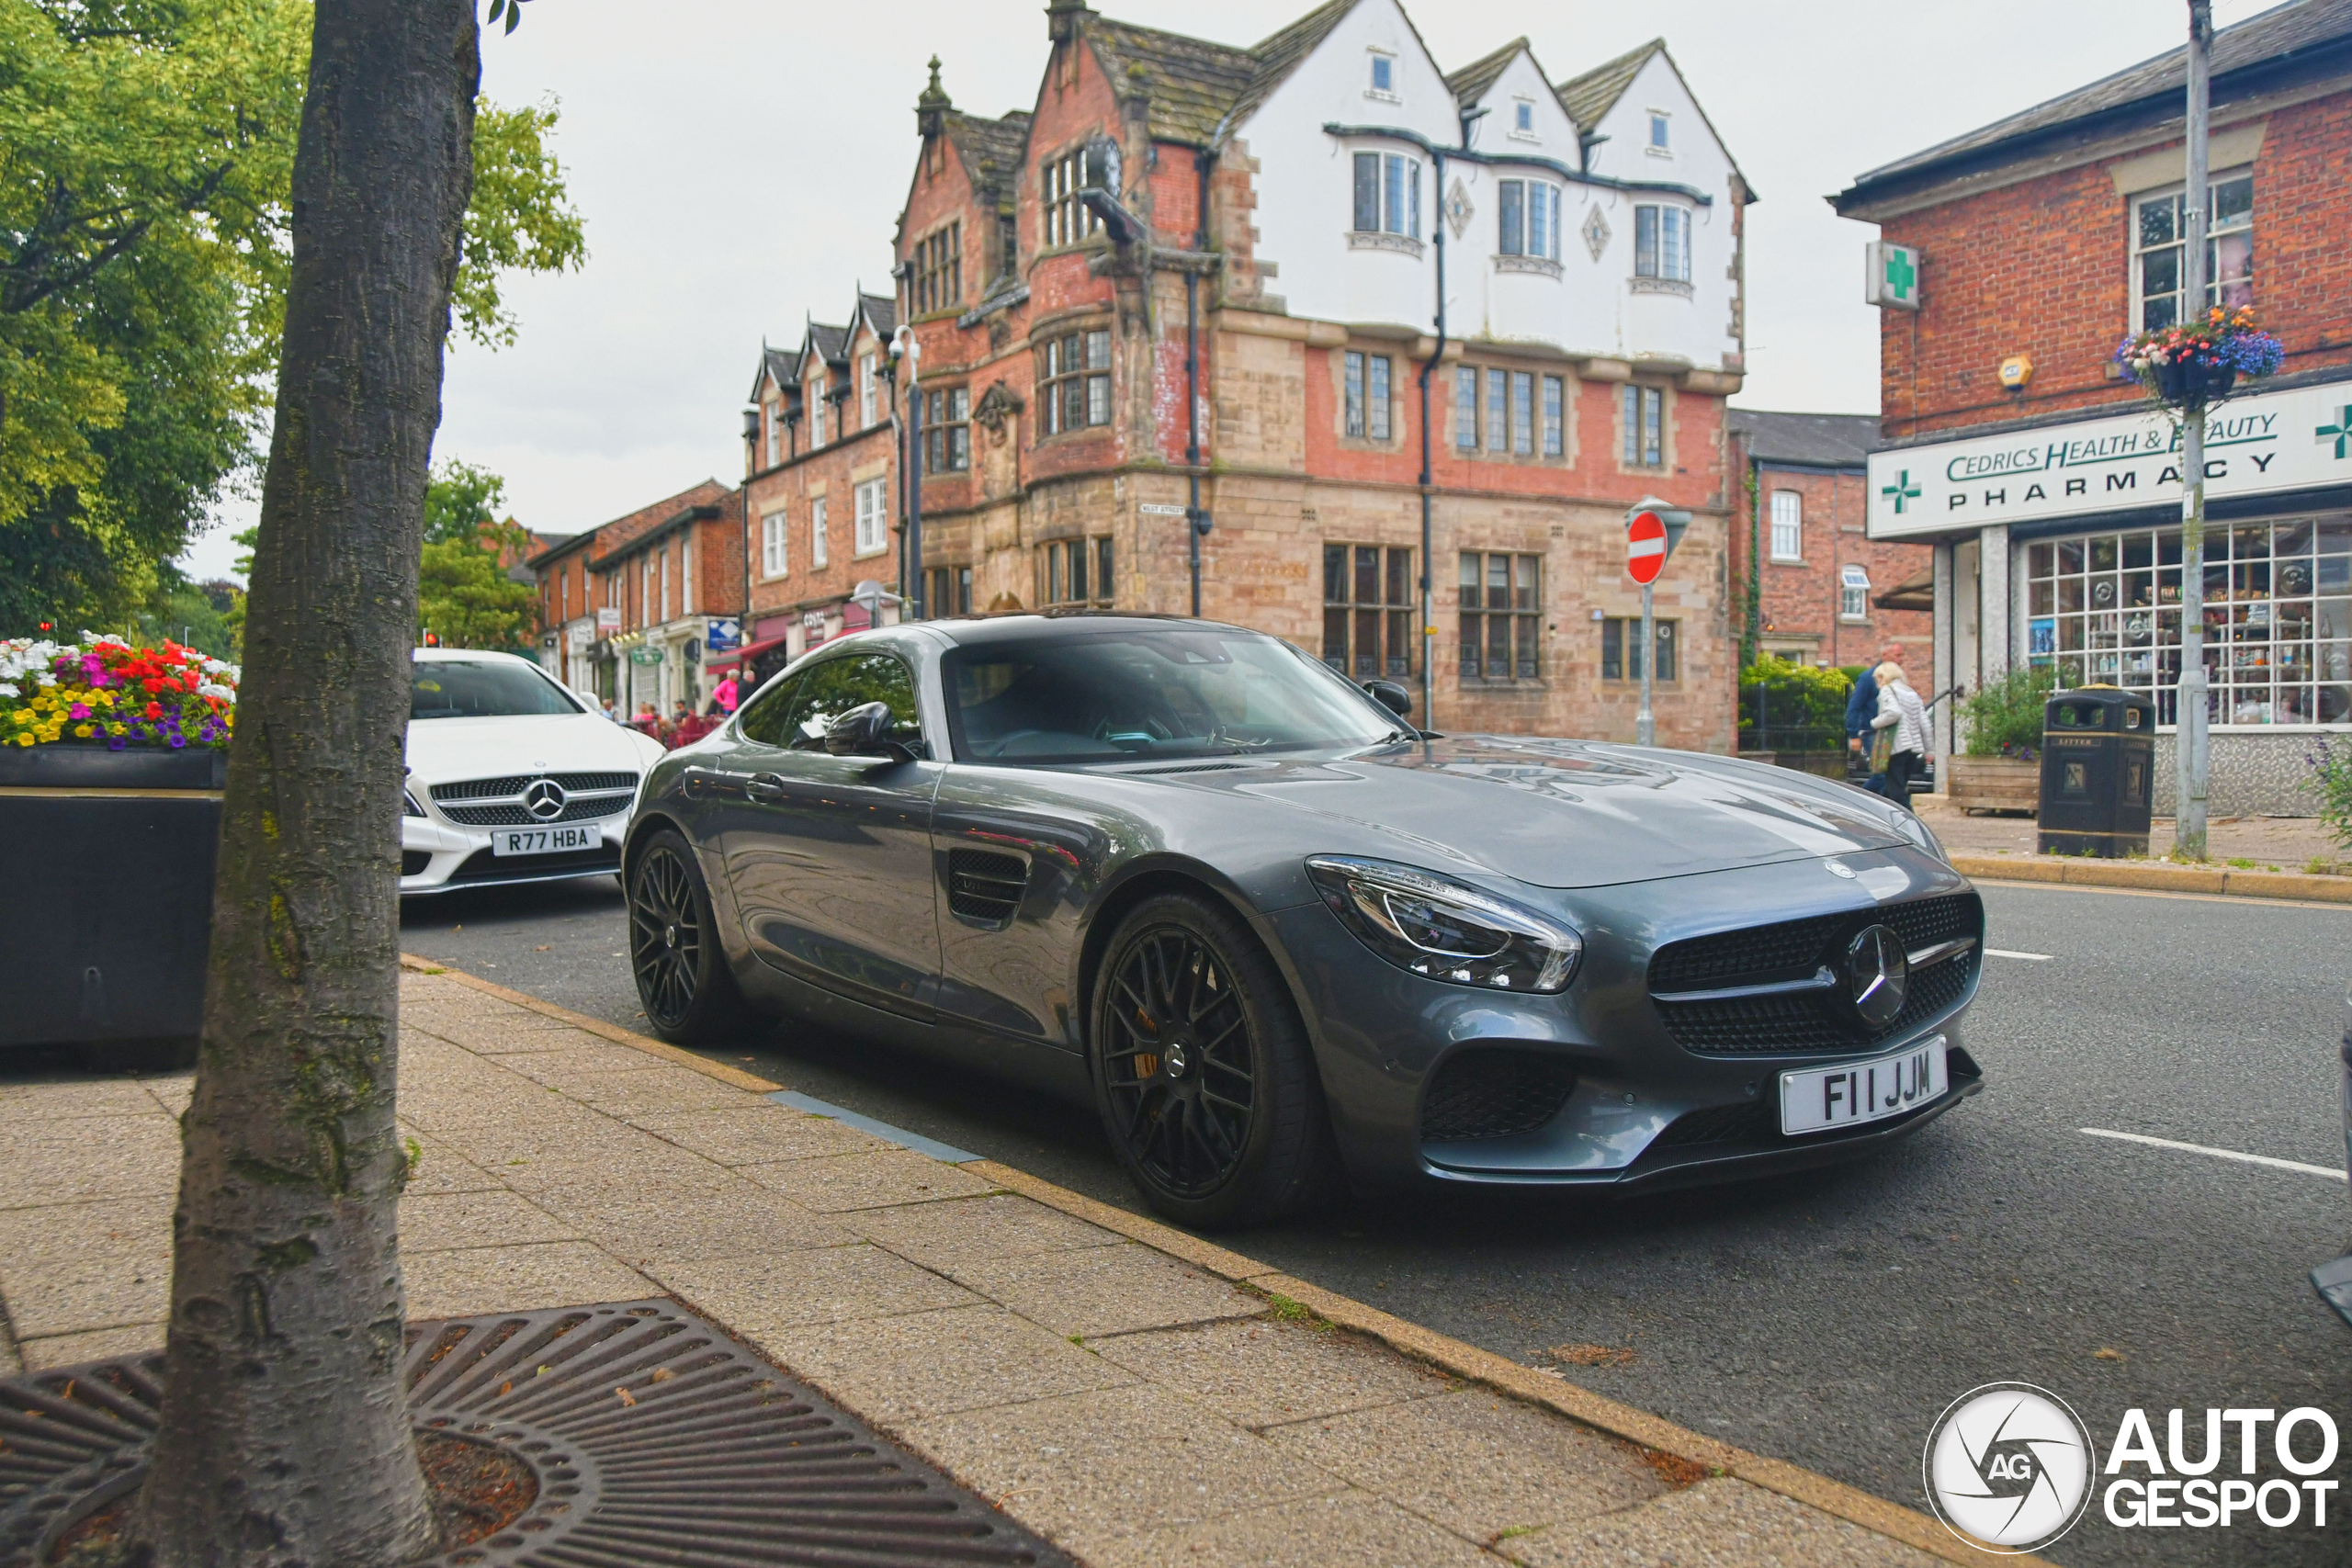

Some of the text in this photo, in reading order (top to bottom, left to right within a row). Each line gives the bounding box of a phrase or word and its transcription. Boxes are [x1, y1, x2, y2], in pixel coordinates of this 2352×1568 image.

[1947, 412, 2278, 481] CEDRICS HEALTH & AUTY
[1949, 452, 2277, 511] PHARMACY
[509, 829, 588, 852] R77 HBA
[1884, 1051, 1930, 1107] JJM
